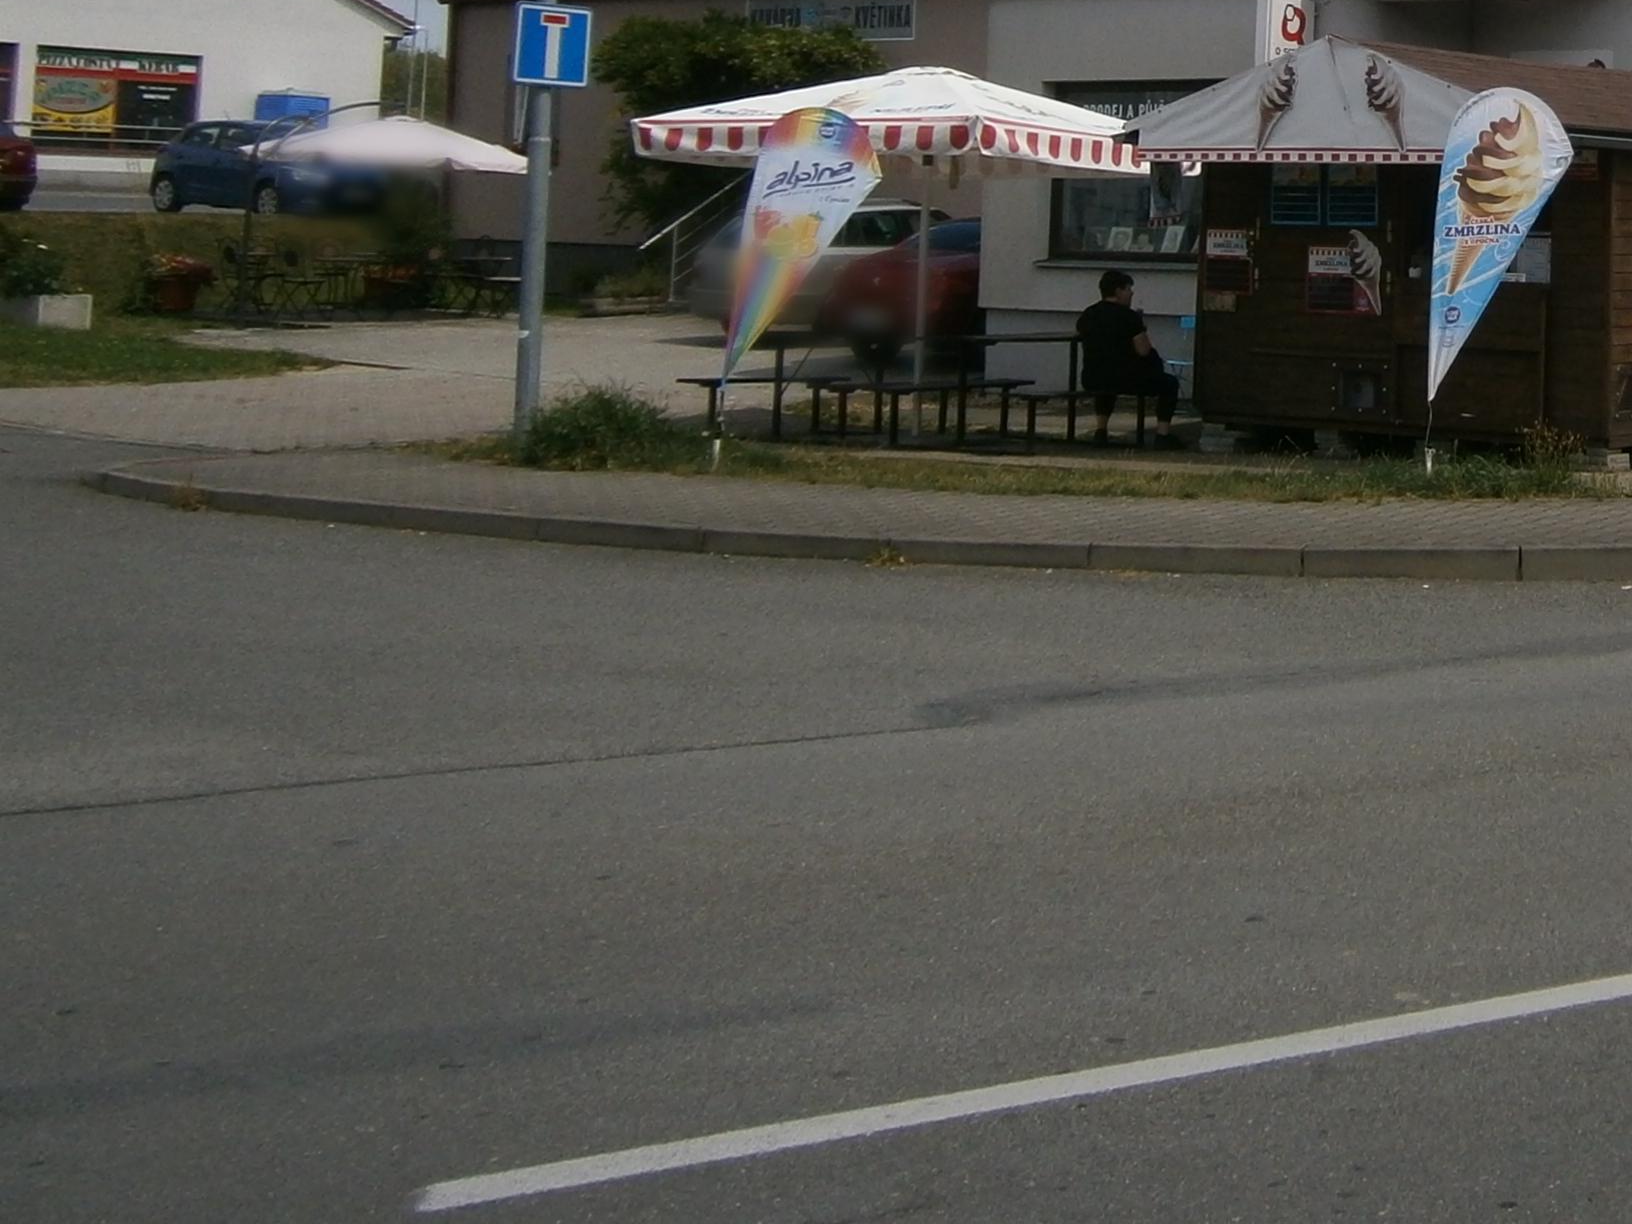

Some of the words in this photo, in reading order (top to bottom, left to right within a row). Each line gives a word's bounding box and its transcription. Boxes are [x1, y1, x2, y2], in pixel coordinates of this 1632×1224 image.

[1126, 104, 1134, 119] A
[765, 160, 855, 191] alpina
[1444, 224, 1520, 237] ZMRZLINA
